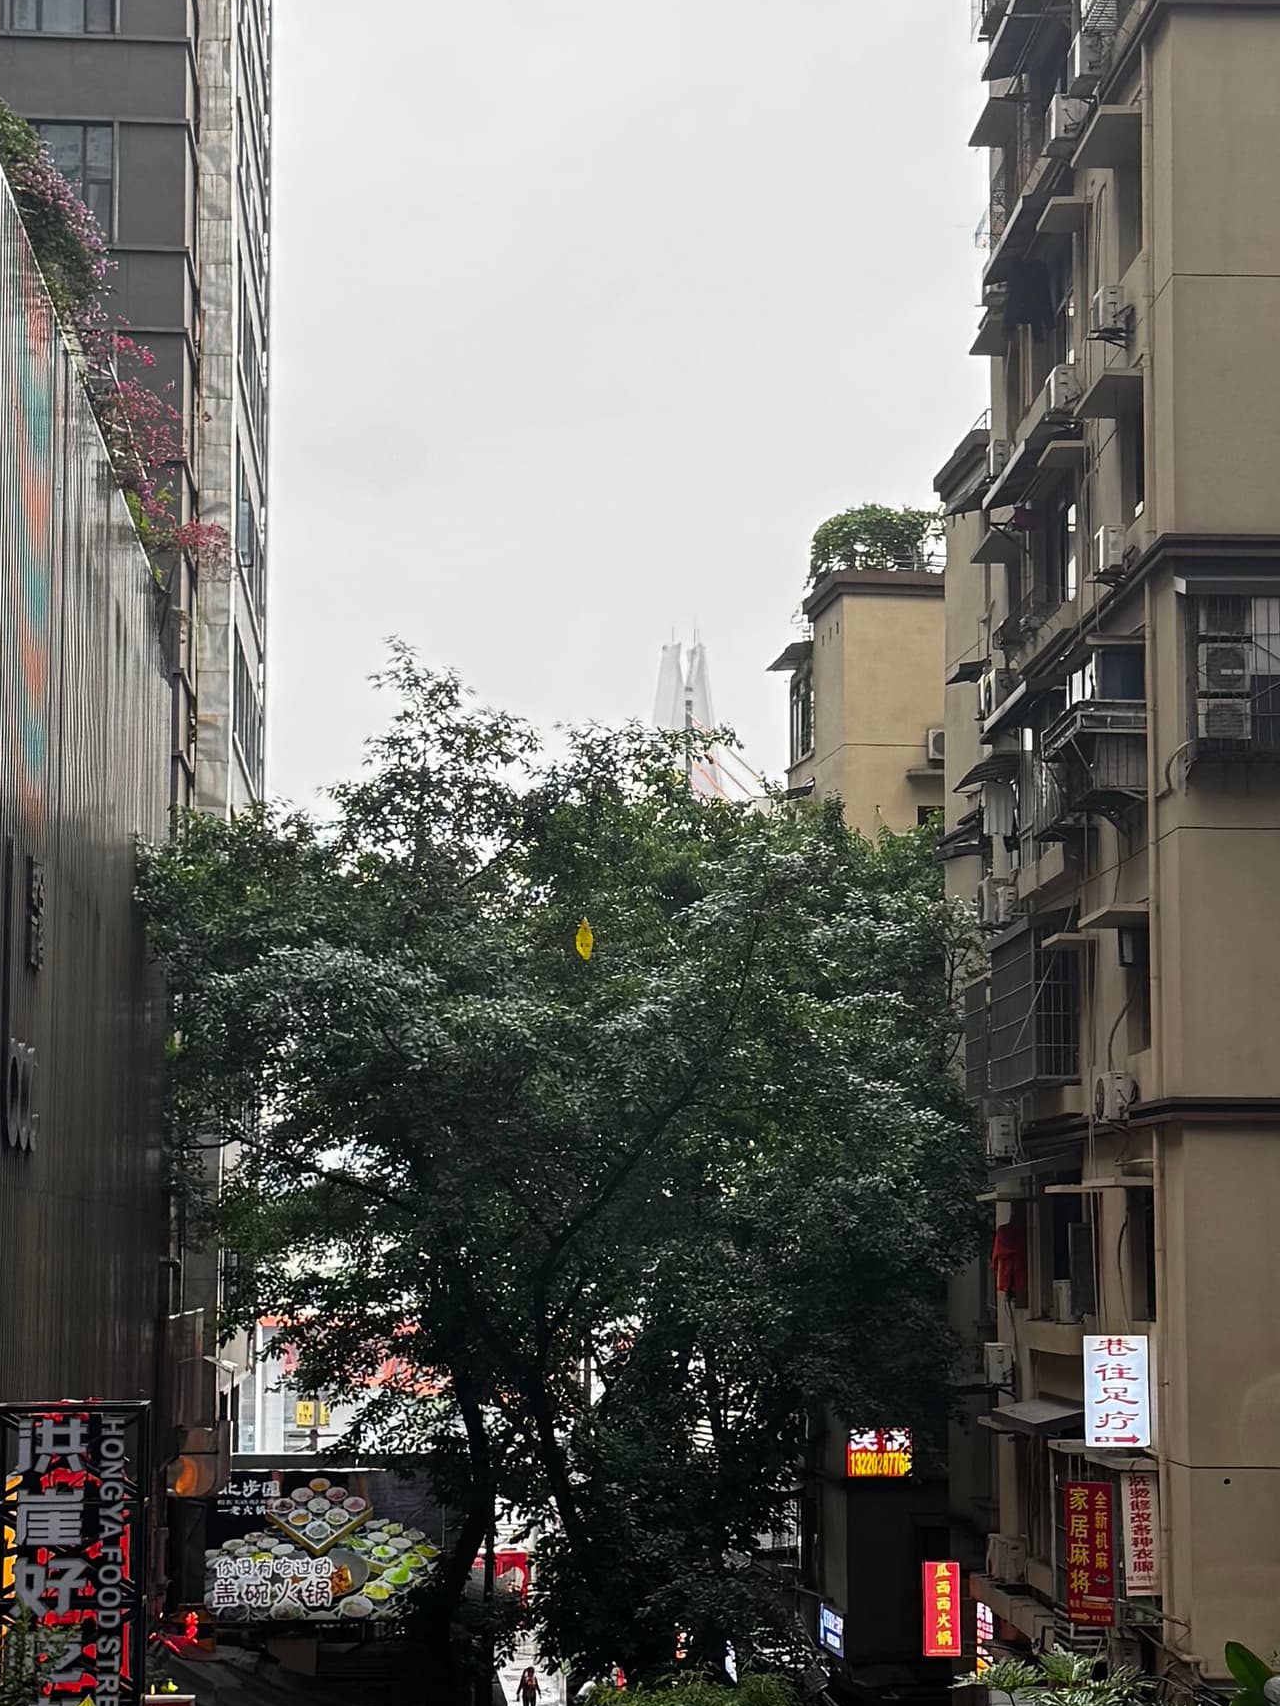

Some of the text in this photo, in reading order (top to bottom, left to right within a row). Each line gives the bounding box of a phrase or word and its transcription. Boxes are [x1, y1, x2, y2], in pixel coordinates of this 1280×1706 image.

[1092, 1337, 1140, 1429] 巷往足疗
[98, 1412, 126, 1539] HONGYA
[217, 1557, 333, 1578] 你没有吃过的
[1068, 1486, 1091, 1594] 家居麻将
[1093, 1491, 1109, 1571] 全新机麻
[95, 1544, 123, 1631] FOOD
[214, 1578, 333, 1607] 盖碗火锅
[935, 1562, 953, 1646] 瓜西西火锅
